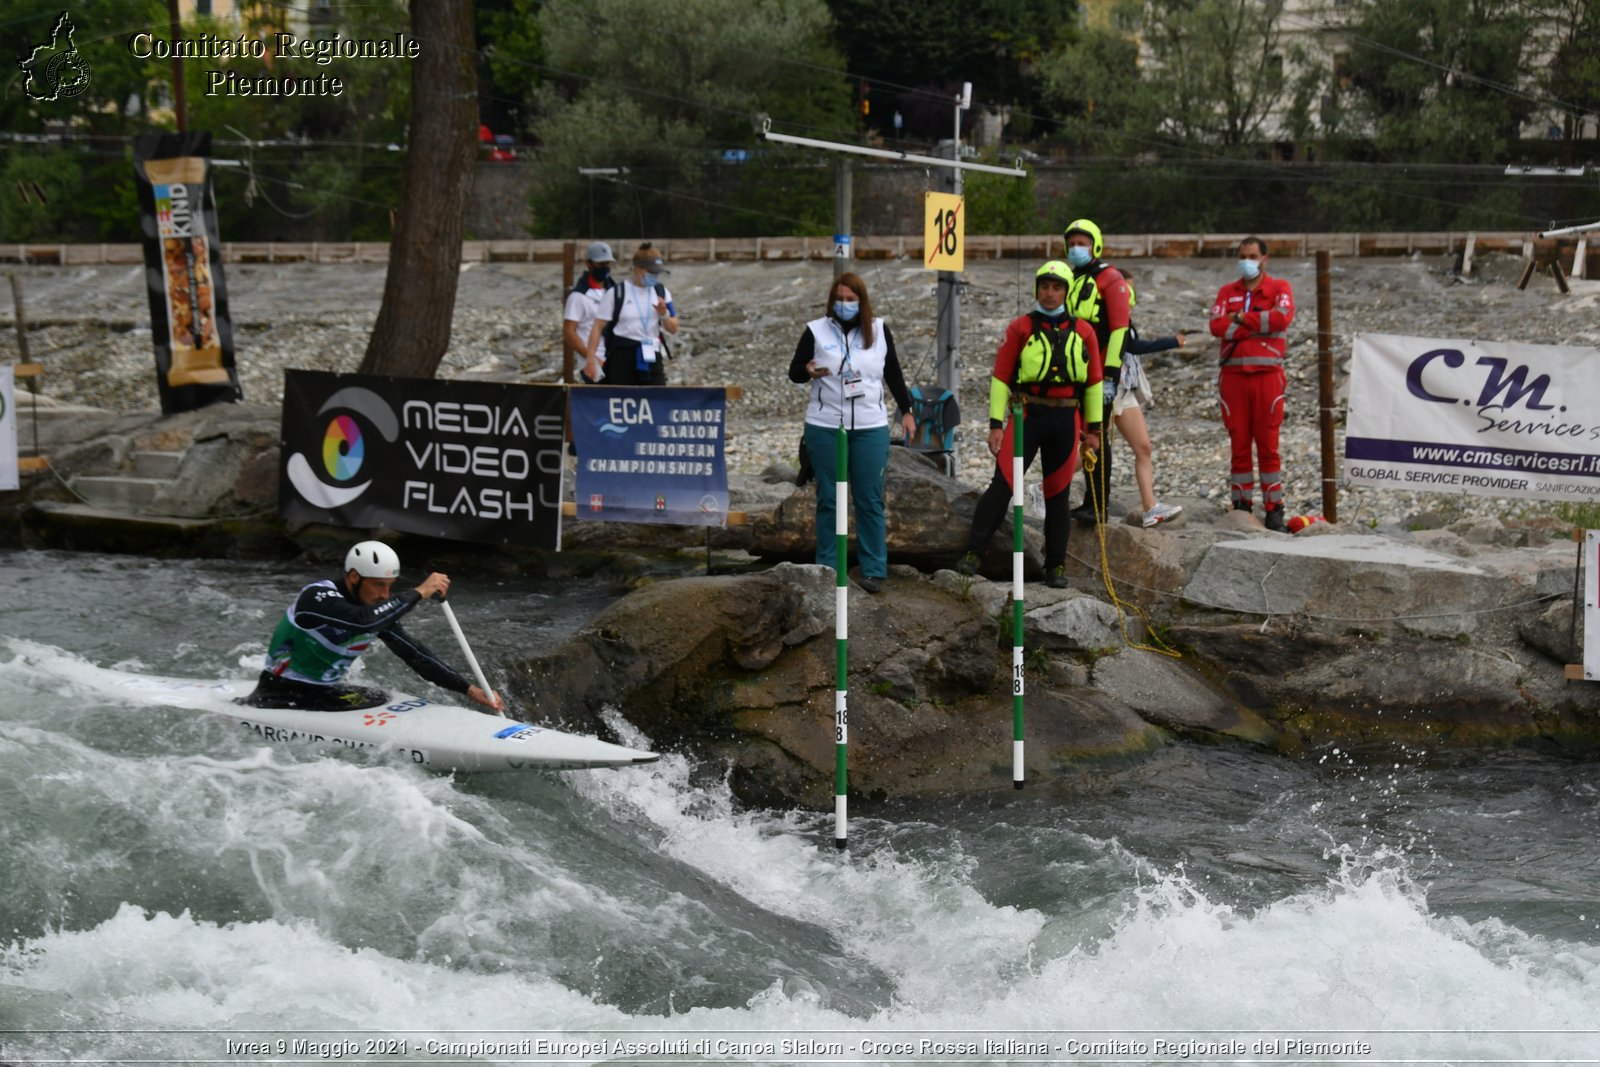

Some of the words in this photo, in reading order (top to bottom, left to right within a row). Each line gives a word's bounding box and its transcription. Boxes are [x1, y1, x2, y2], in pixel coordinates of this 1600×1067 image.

[169, 183, 192, 236] KIND
[934, 208, 957, 256] 18
[403, 400, 529, 437] MEDIA
[609, 397, 654, 425] ECA
[670, 409, 722, 423] CANOE
[1476, 404, 1585, 438] Service
[658, 425, 718, 439] SLALOM
[405, 440, 530, 480] VIDEO
[636, 442, 716, 458] EUROPEAN
[1412, 445, 1600, 473] www.cmservicesrl.it
[588, 458, 713, 476] CHAMPIONSHIPS
[1350, 466, 1402, 481] GLOBAL
[1404, 470, 1460, 486] SERVICE
[1461, 475, 1529, 491] PROVIDER
[403, 480, 534, 522] FLASH
[836, 710, 848, 725] 18
